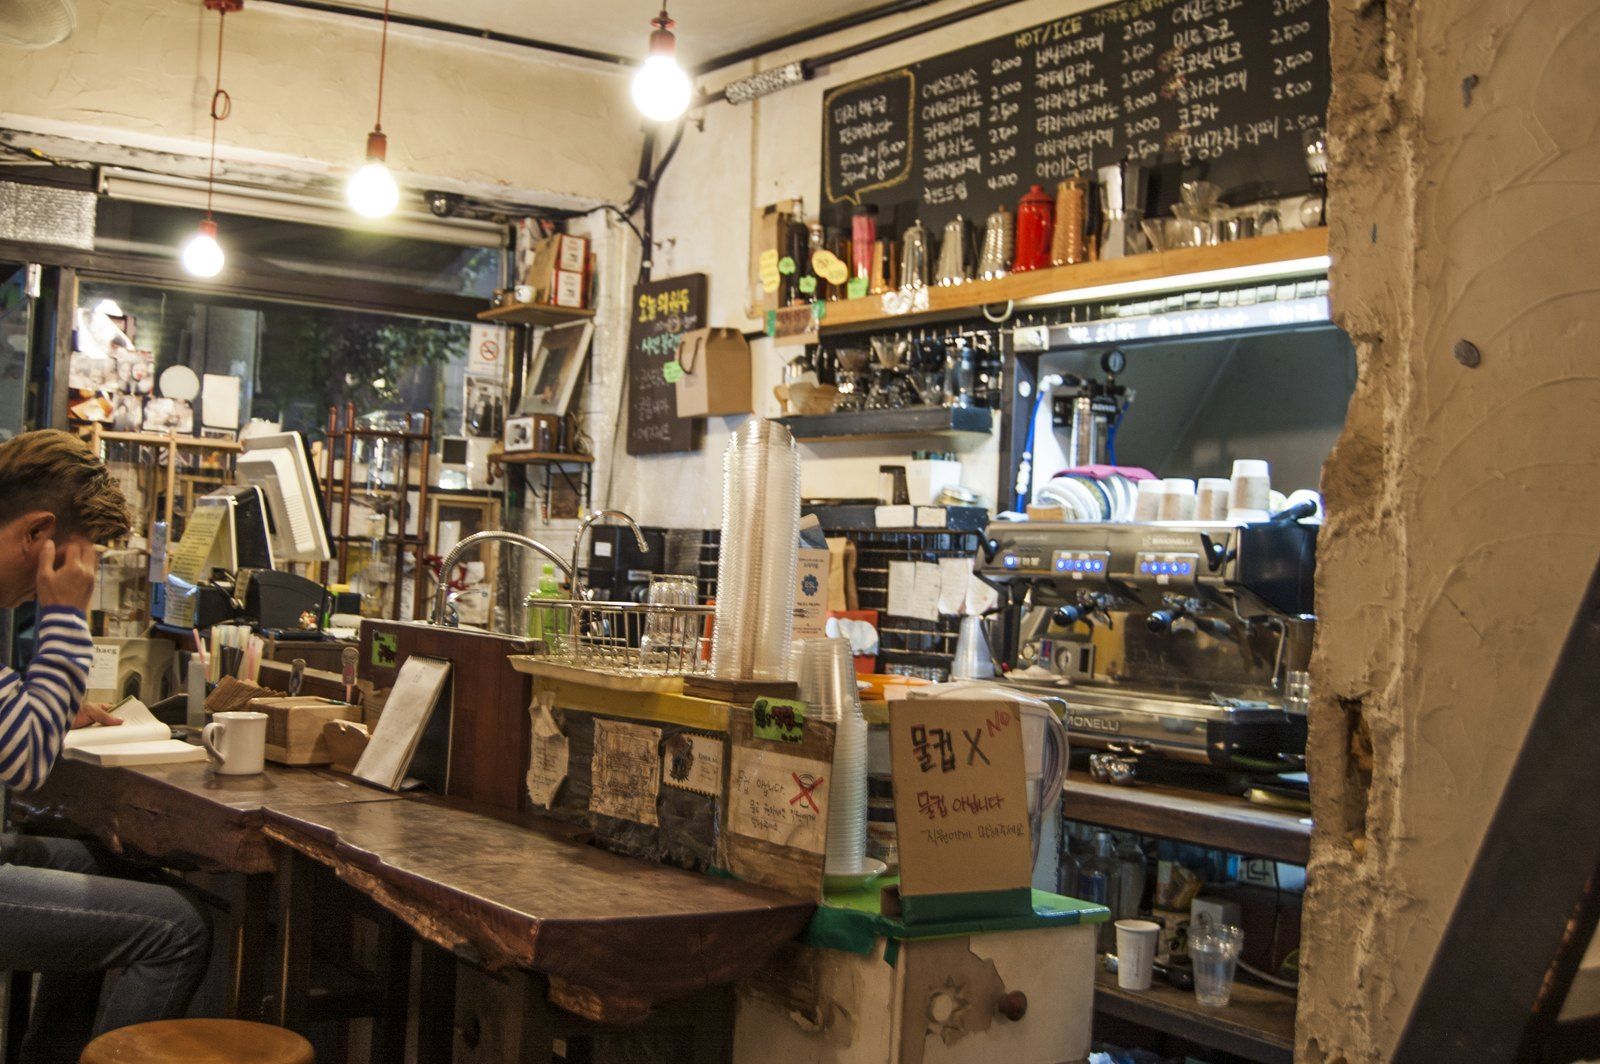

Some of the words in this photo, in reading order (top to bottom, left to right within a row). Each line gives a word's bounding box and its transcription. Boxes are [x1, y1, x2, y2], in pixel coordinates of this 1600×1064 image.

[1015, 16, 1082, 48] HOT/ICE
[1068, 715, 1120, 732] MONELLI
[910, 723, 956, 774] 물컵
[962, 727, 991, 767] X
[952, 793, 1006, 816] 아닙니다
